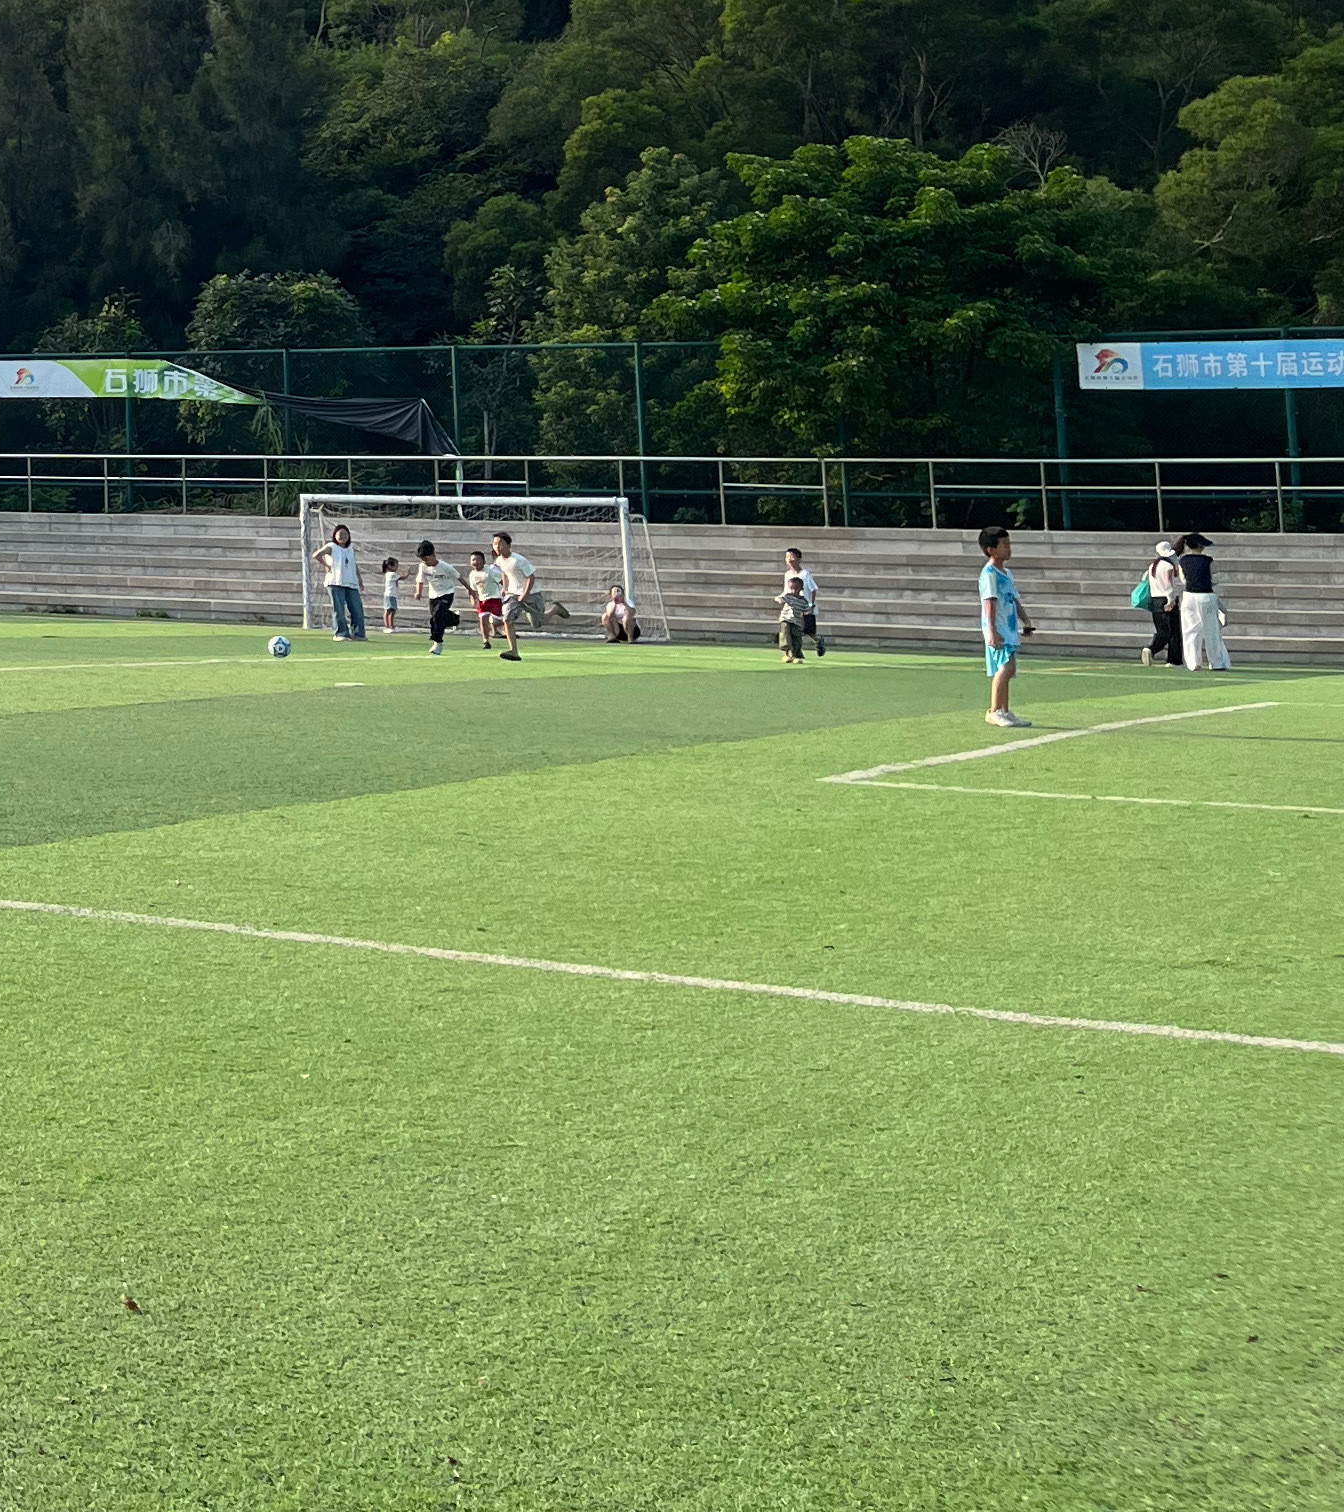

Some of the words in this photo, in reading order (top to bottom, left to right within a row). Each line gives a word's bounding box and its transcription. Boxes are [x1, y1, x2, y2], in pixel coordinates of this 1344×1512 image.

[1151, 352, 1344, 378] 石狮市第十届运动
